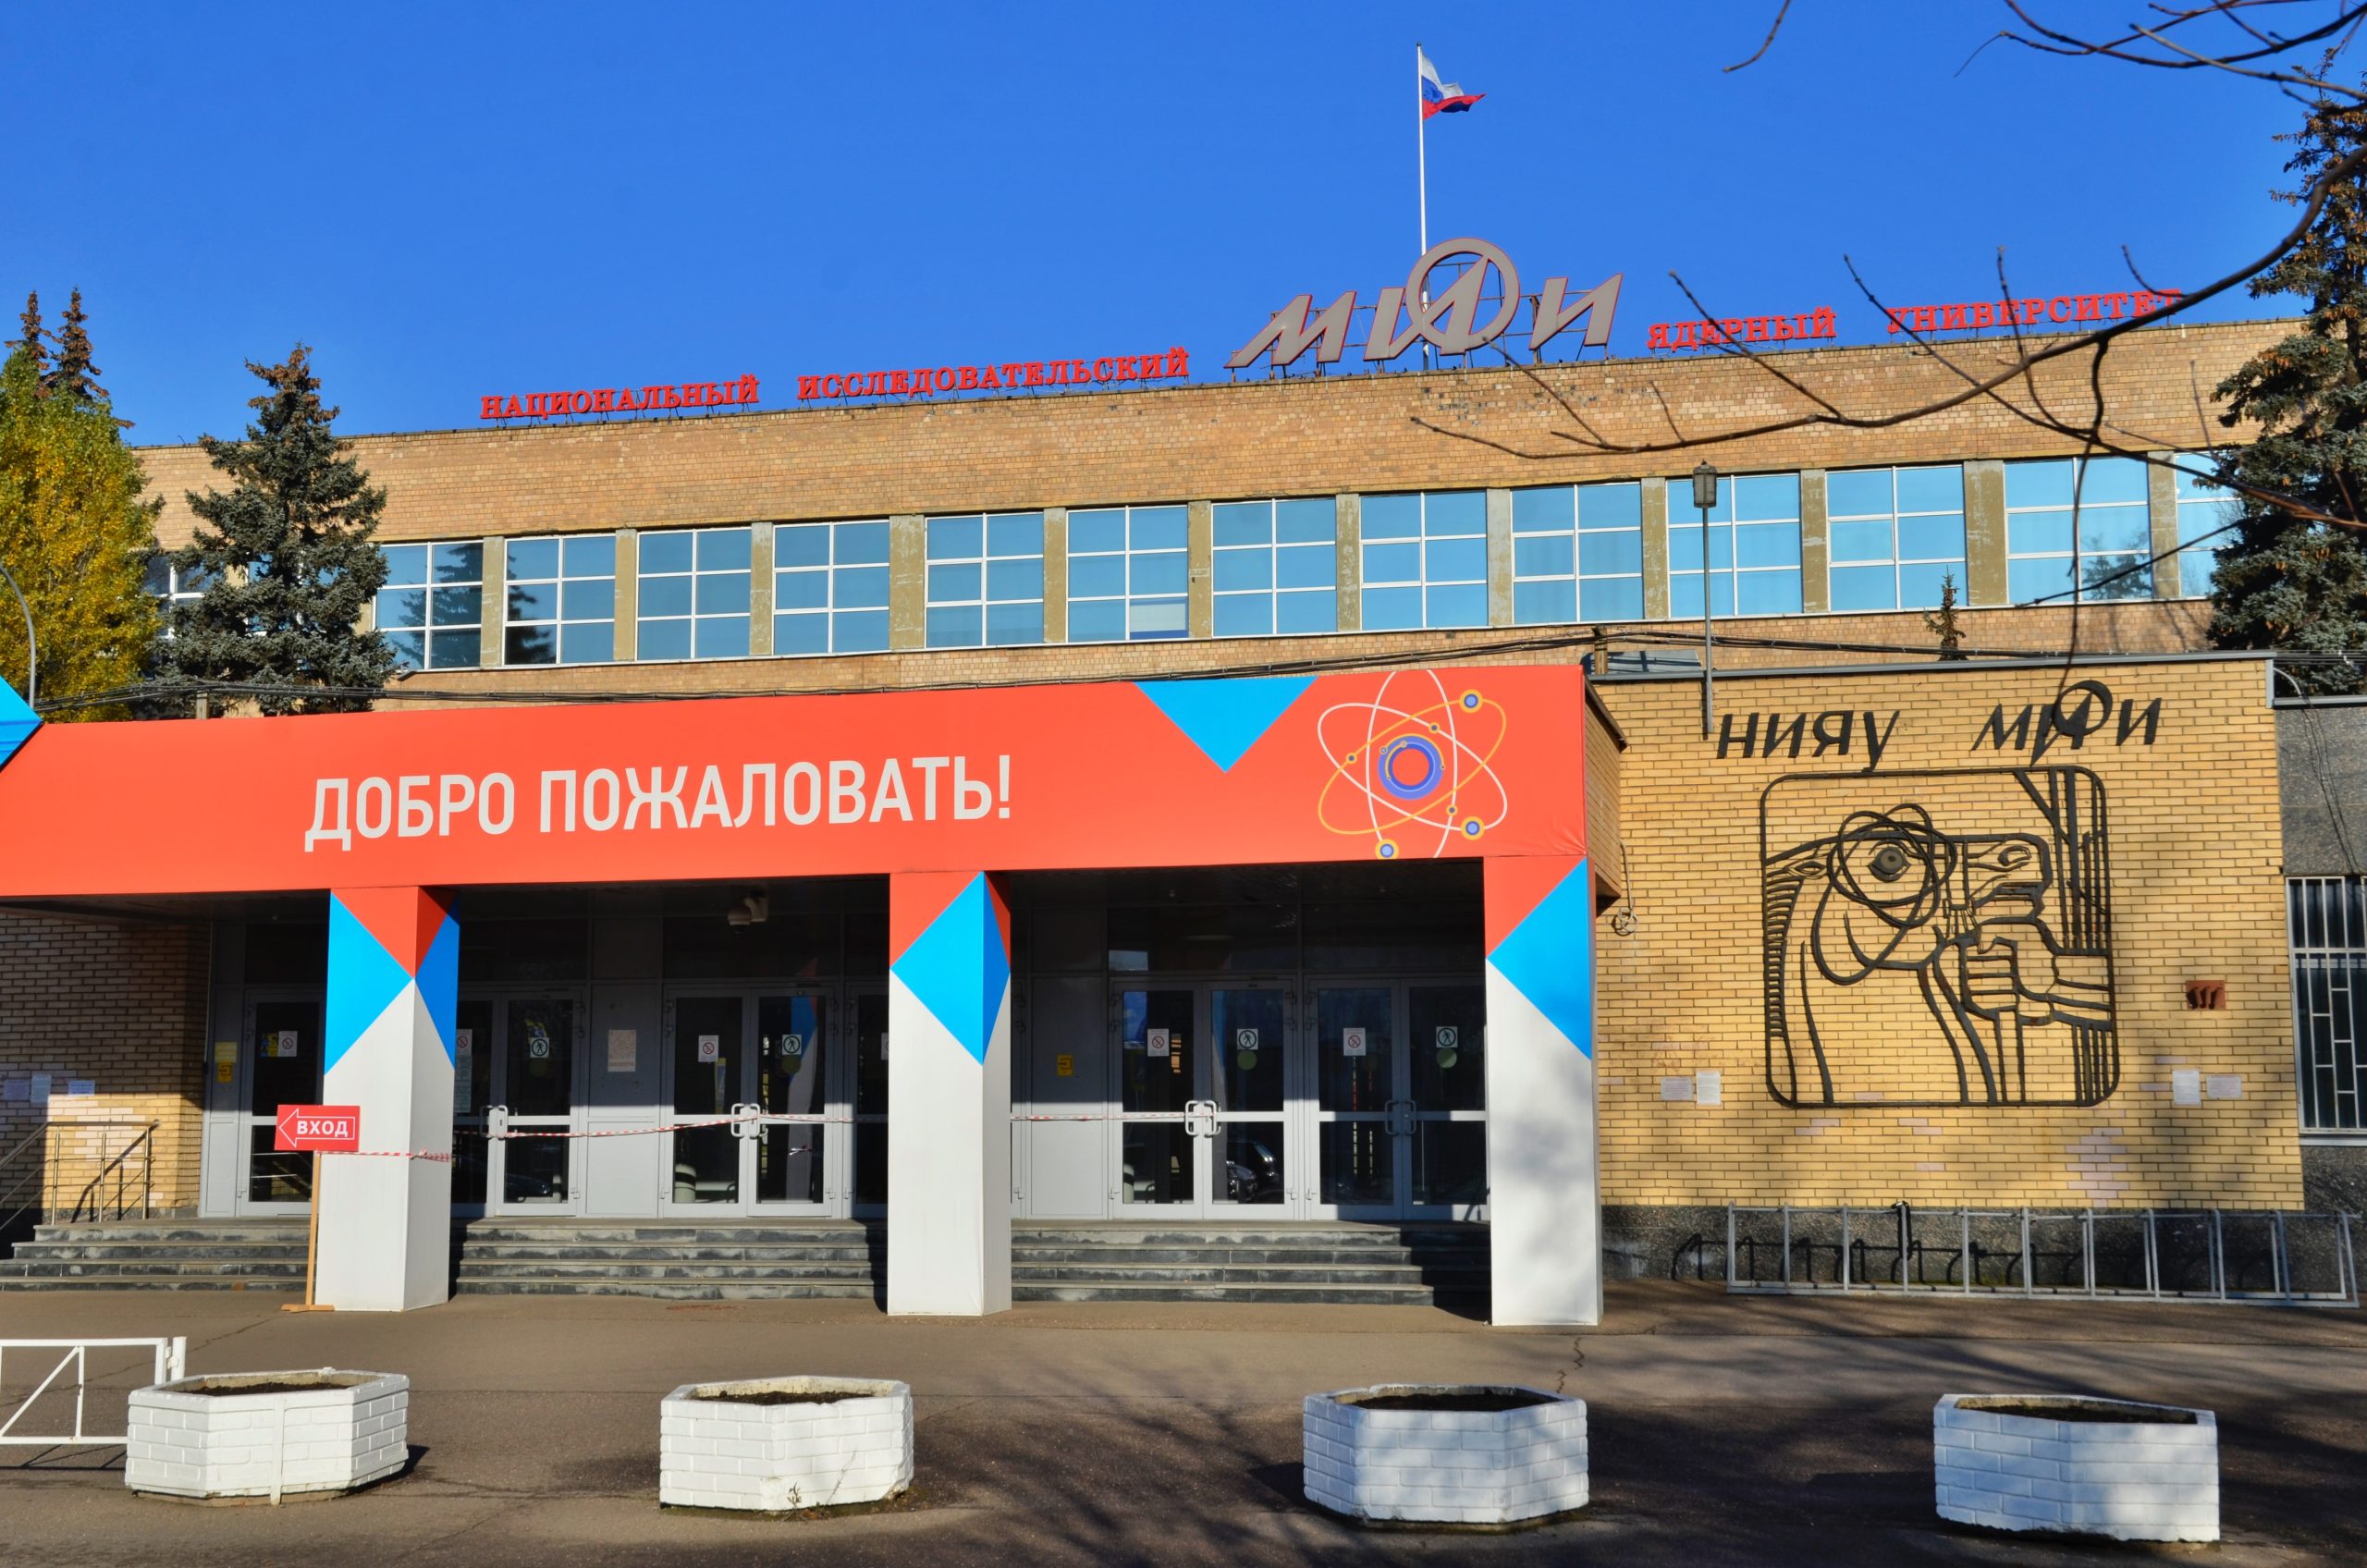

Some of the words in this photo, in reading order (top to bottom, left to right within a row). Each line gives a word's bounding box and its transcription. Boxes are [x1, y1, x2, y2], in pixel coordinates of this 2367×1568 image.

[1647, 306, 1836, 352] ЯДЕРНЫЙ
[481, 374, 759, 420] НАЦИОНАЛЬНЫЙ
[798, 347, 1189, 400] ИССЛЕДОВАТЕЛЬСКИЙ
[1716, 709, 1900, 773] НИЯУ
[304, 772, 515, 852] ДОБРО
[540, 754, 1012, 833] ПОЖАЛОВАТЬ!
[297, 1120, 349, 1138] ВХОД
